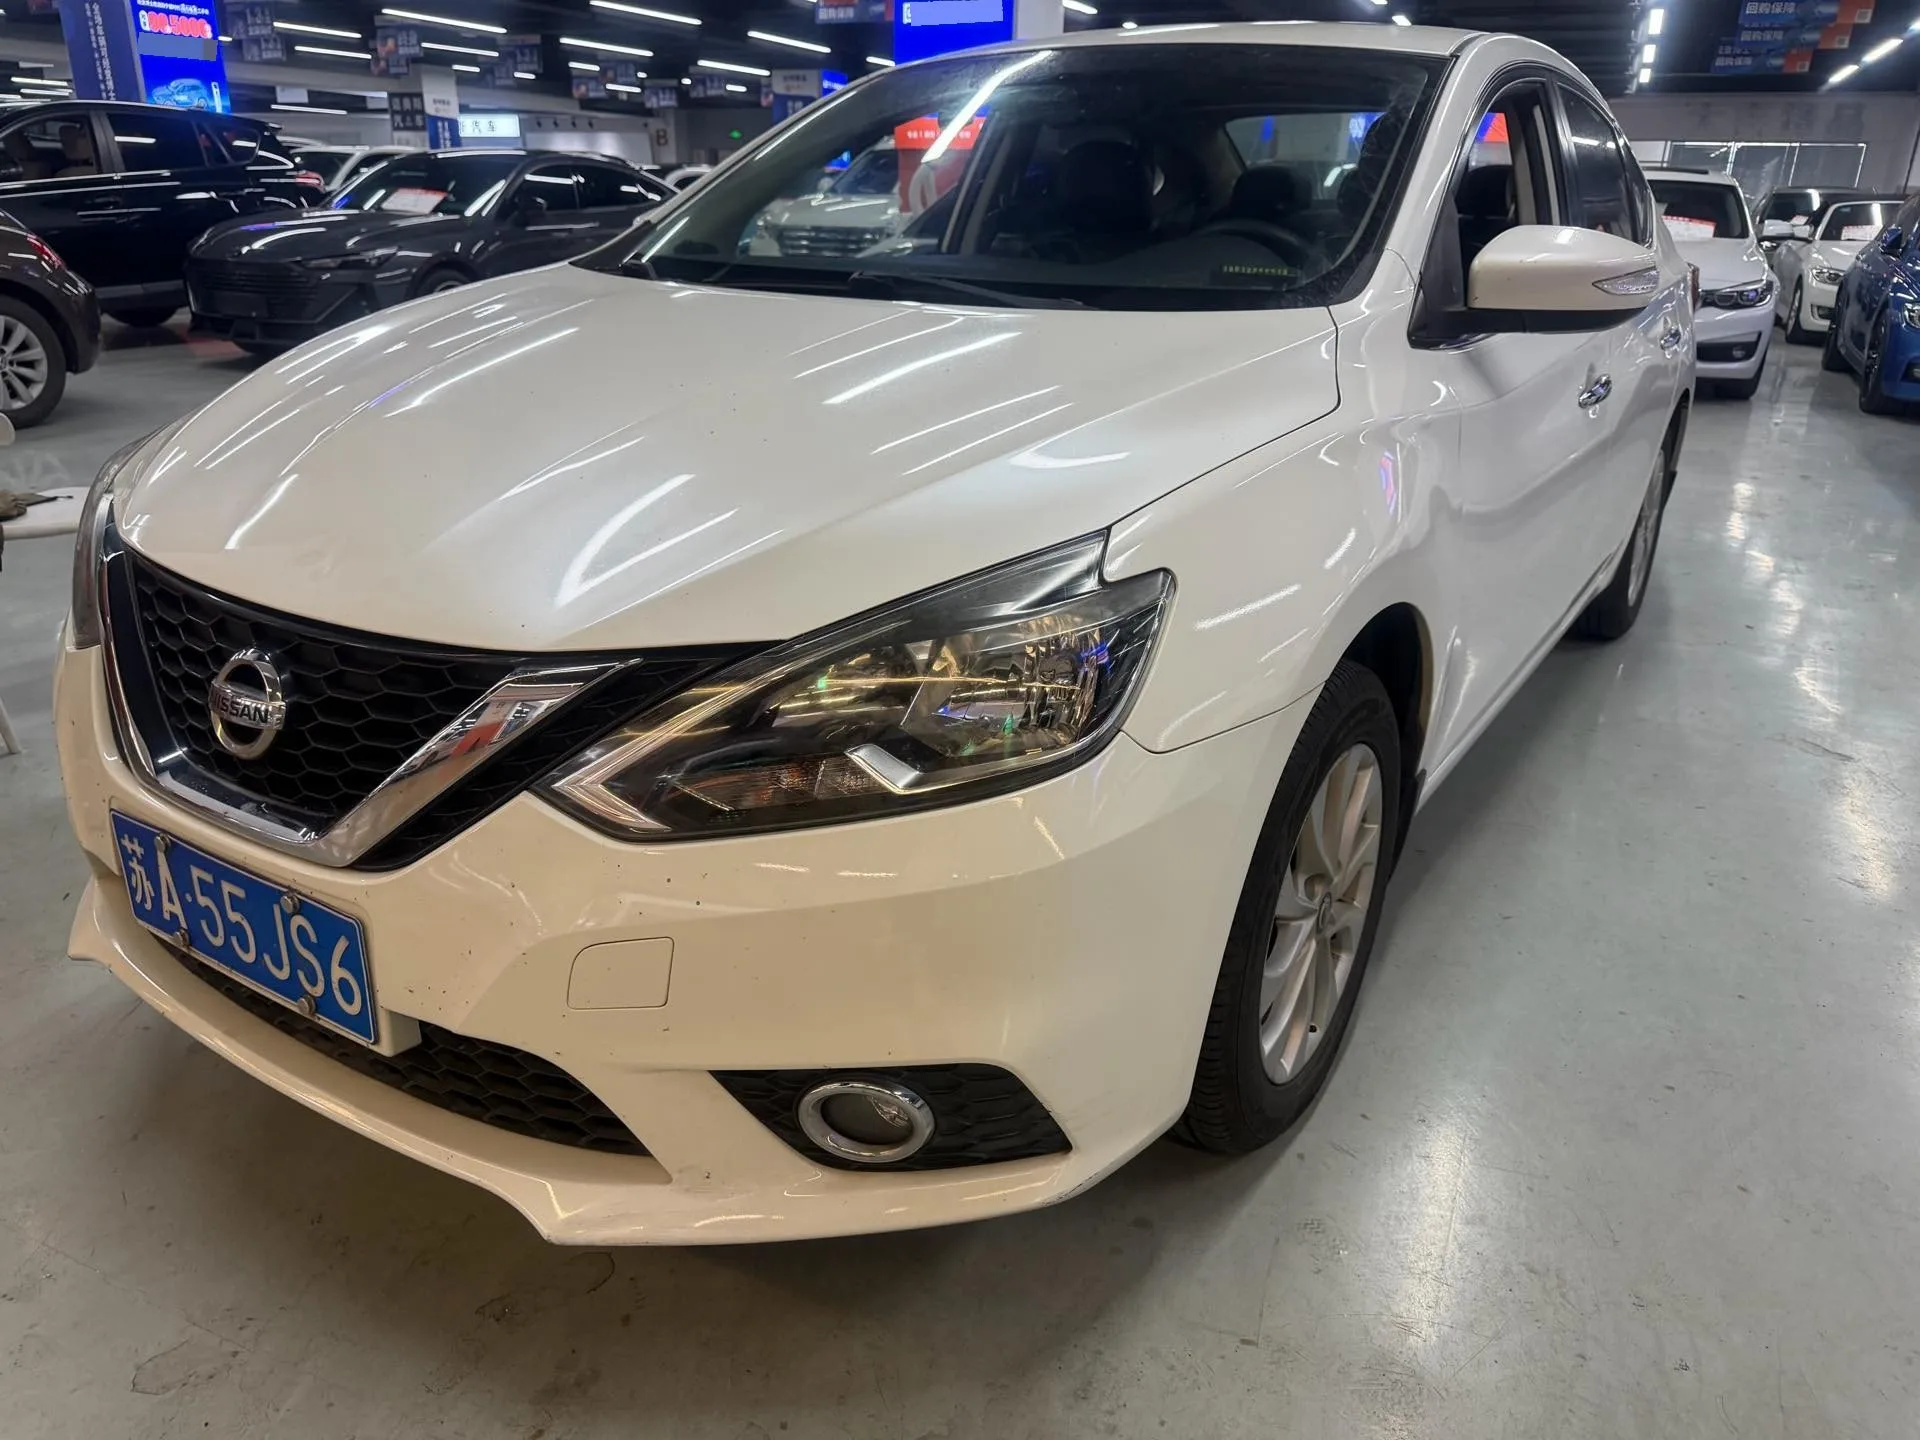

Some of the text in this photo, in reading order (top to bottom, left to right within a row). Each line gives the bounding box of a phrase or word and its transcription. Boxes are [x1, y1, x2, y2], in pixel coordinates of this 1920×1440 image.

[1746, 2, 1796, 15] 回购保障
[656, 127, 669, 147] B
[211, 684, 270, 724] NISSAN
